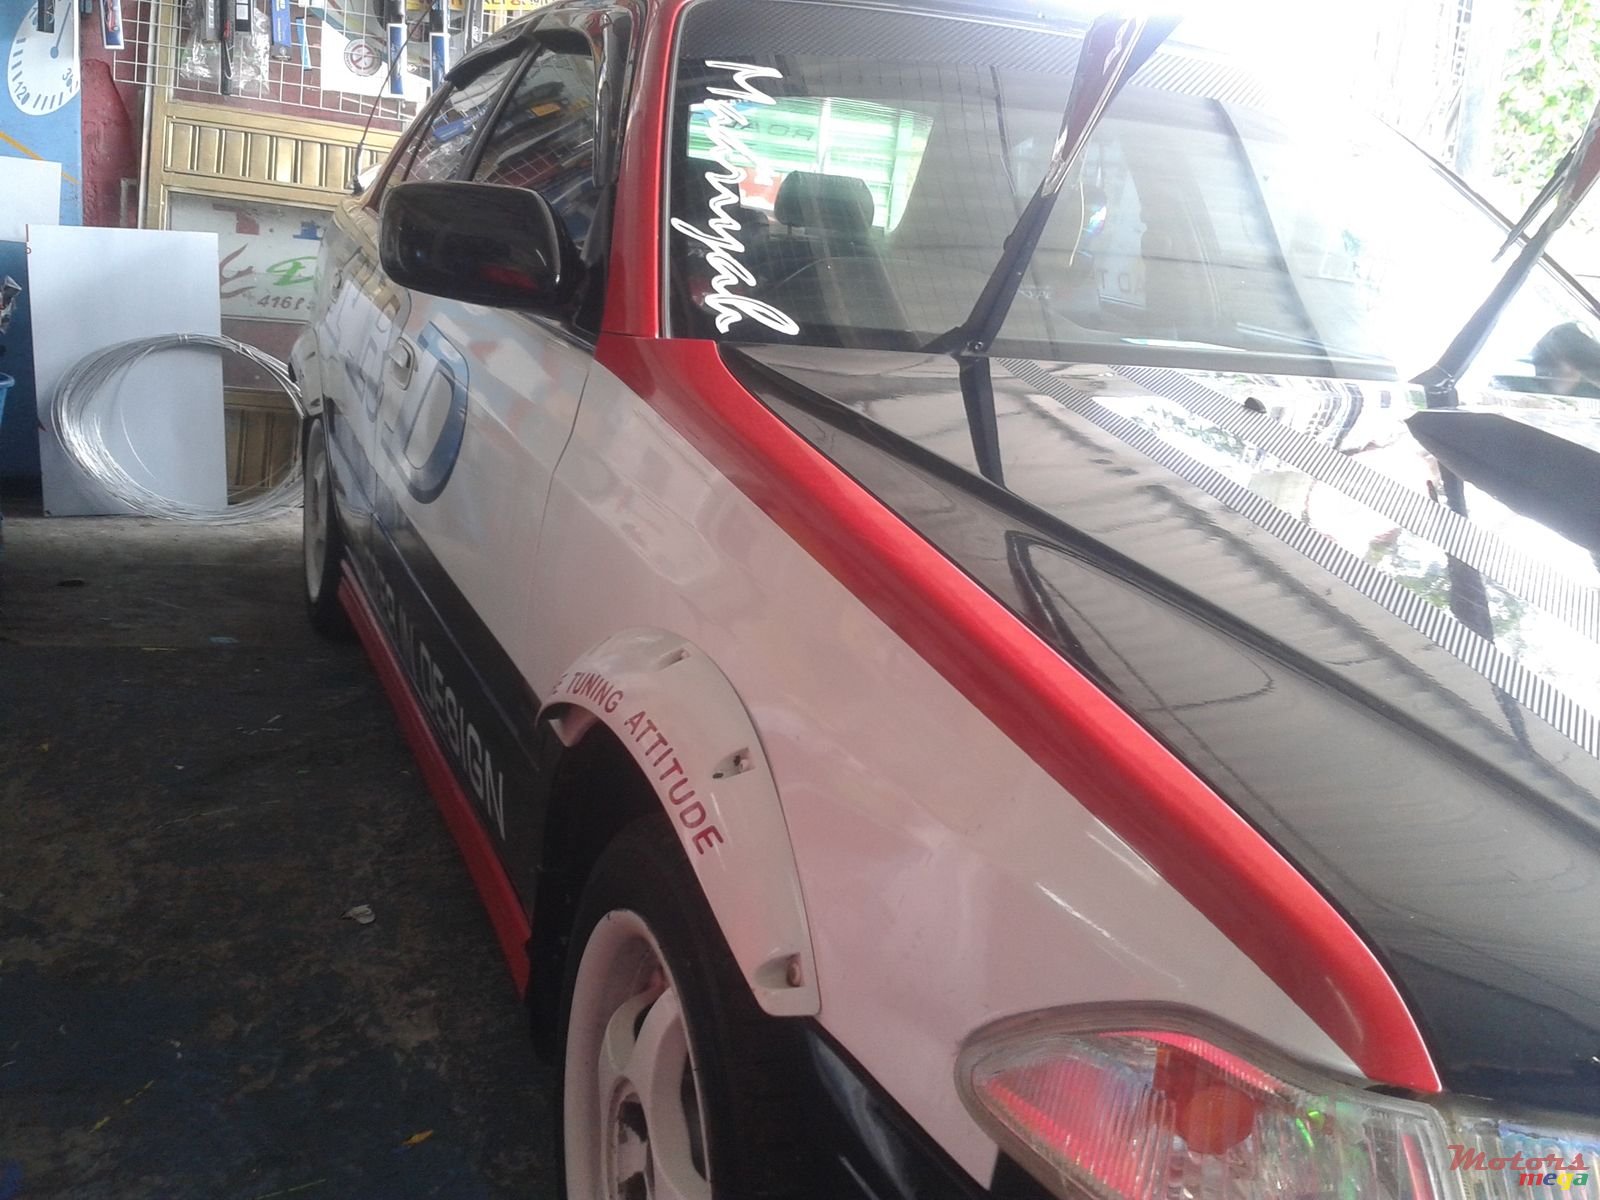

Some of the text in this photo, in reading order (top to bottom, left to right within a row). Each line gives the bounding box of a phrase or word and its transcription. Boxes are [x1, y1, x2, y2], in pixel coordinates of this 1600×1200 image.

[420, 640, 506, 841] DESIGN
[566, 671, 724, 855] TUNING ATTITUDE
